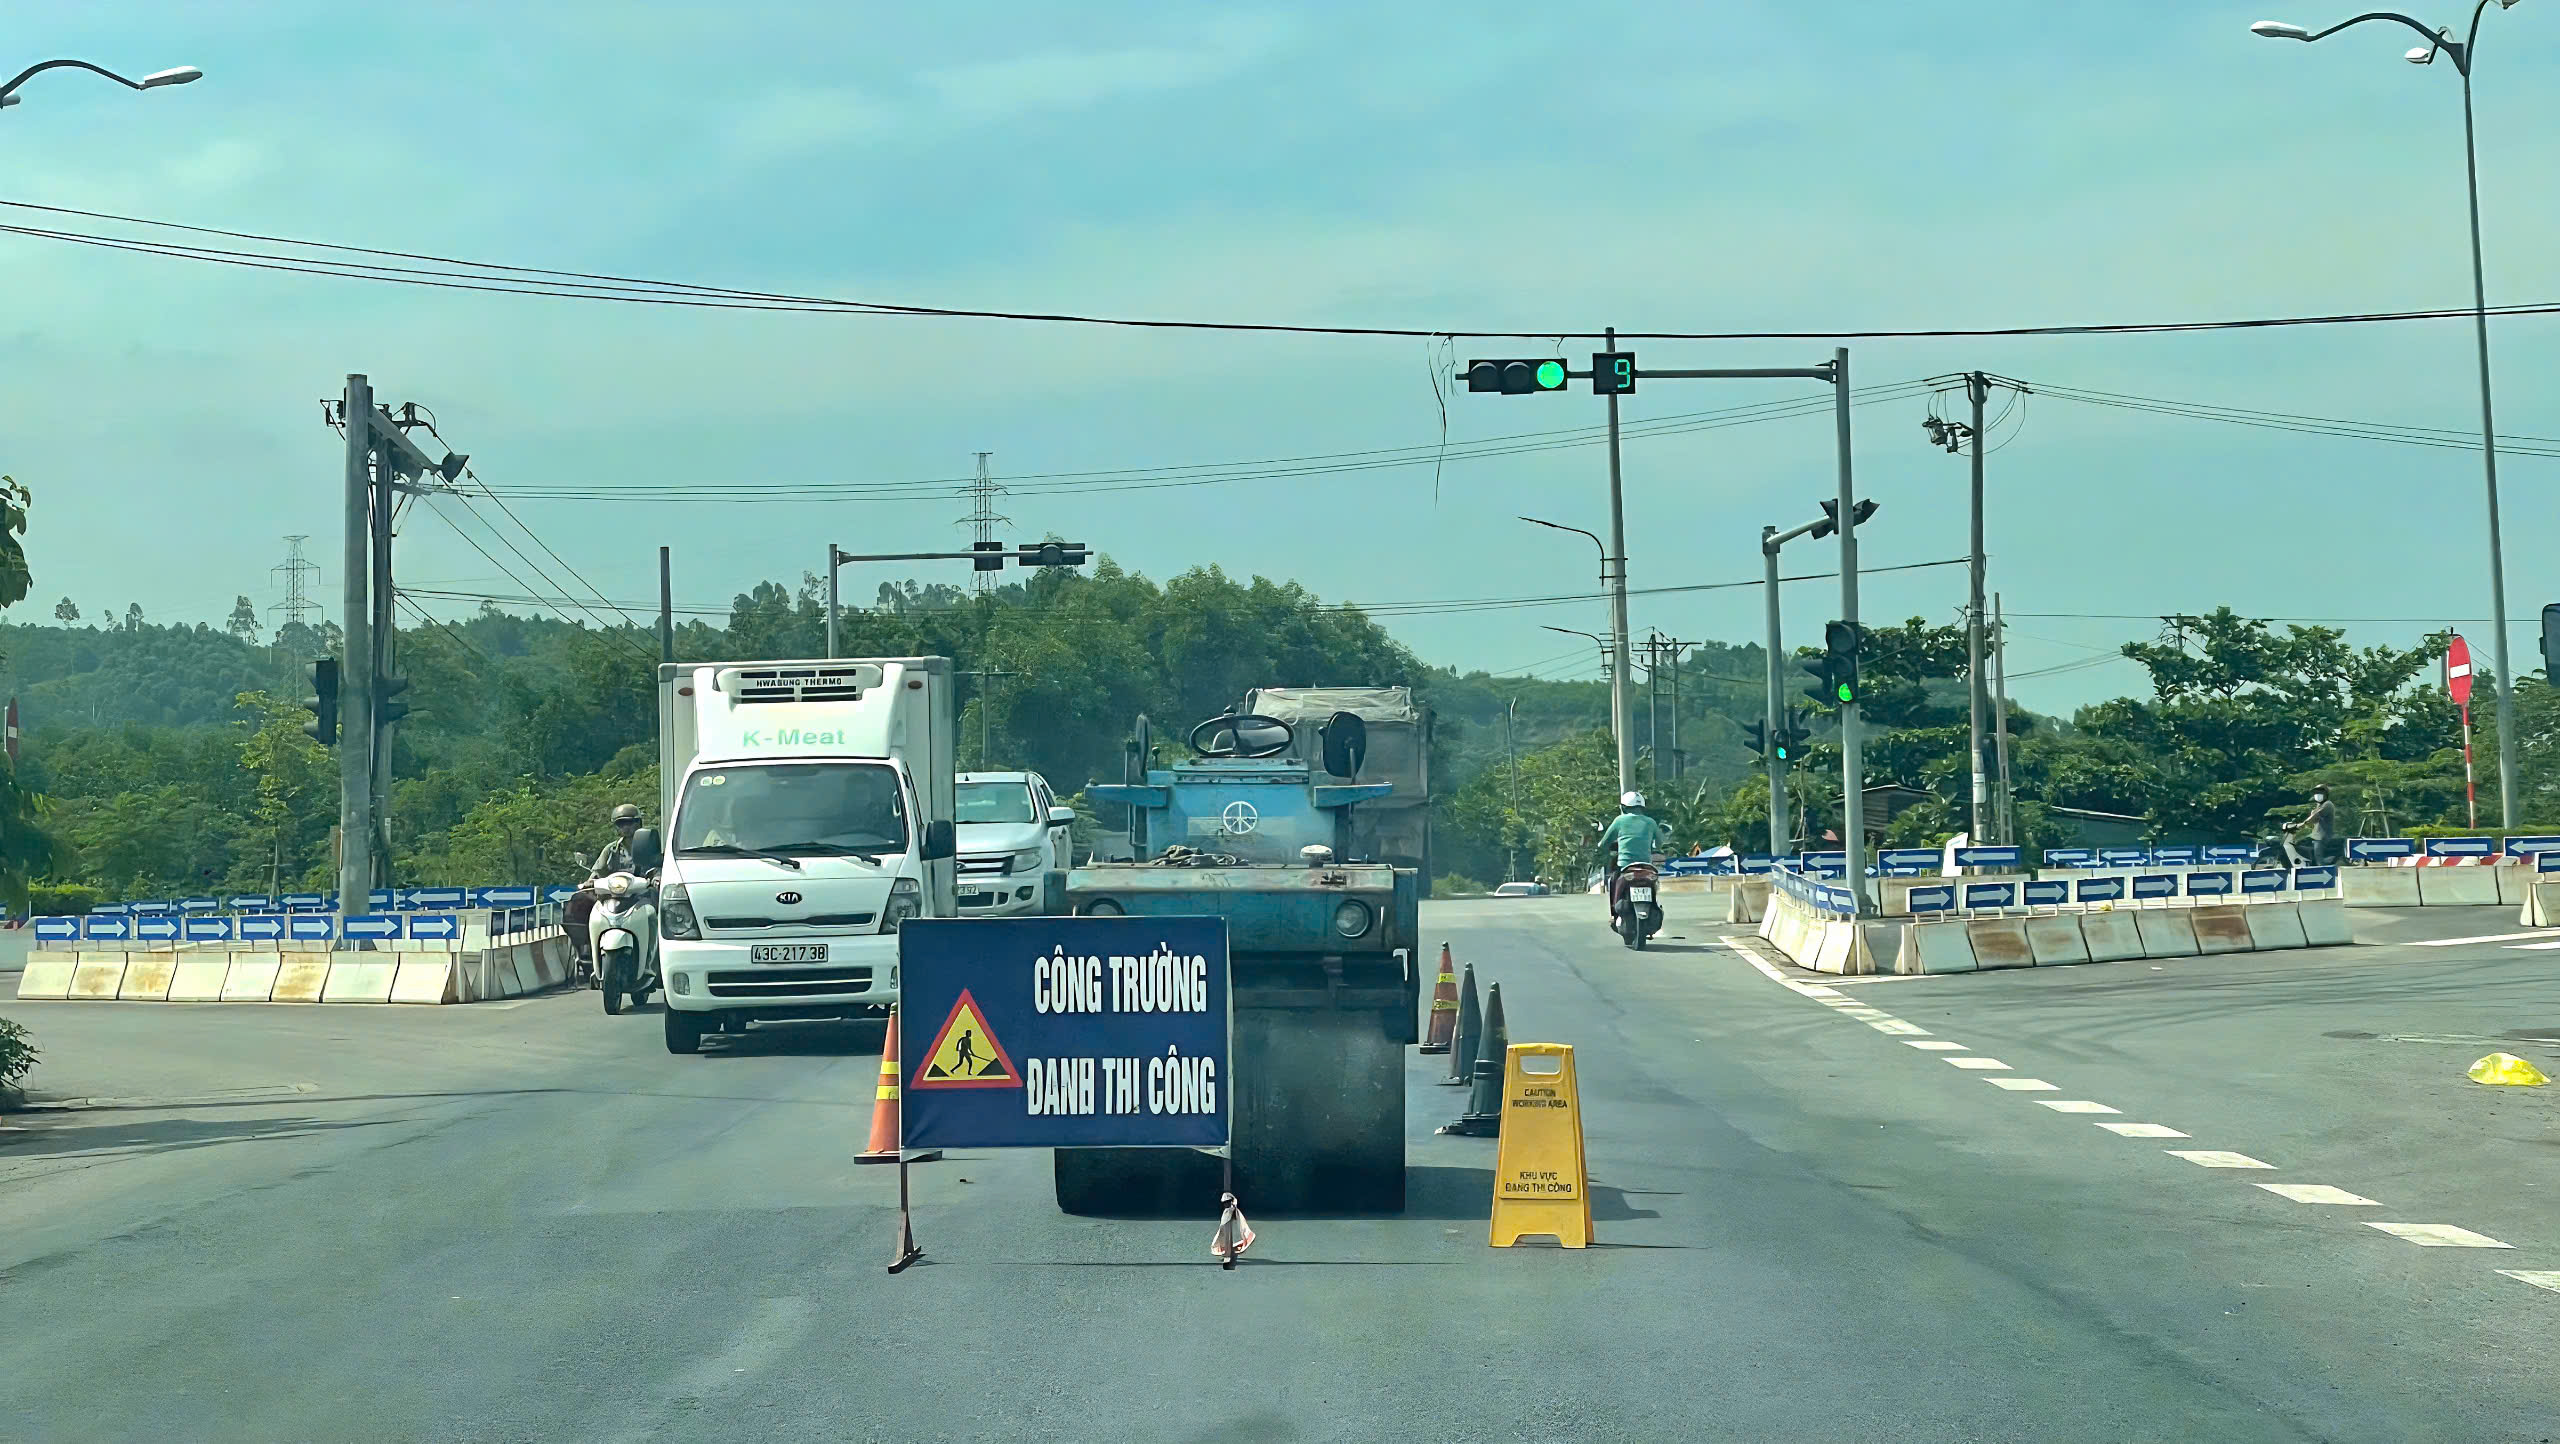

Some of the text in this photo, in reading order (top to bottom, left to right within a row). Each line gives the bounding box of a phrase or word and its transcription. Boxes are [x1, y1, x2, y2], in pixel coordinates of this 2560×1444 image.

[1614, 358, 1631, 389] 9
[804, 677, 842, 686] THERMO
[743, 728, 845, 747] K-Meat
[778, 893, 800, 903] KIA
[1034, 941, 1208, 1014] CÔNG TRƯỜNG
[1102, 1057, 1140, 1115] THI
[1147, 1044, 1216, 1115] CÔNG
[1524, 1088, 1556, 1098] CAUTION
